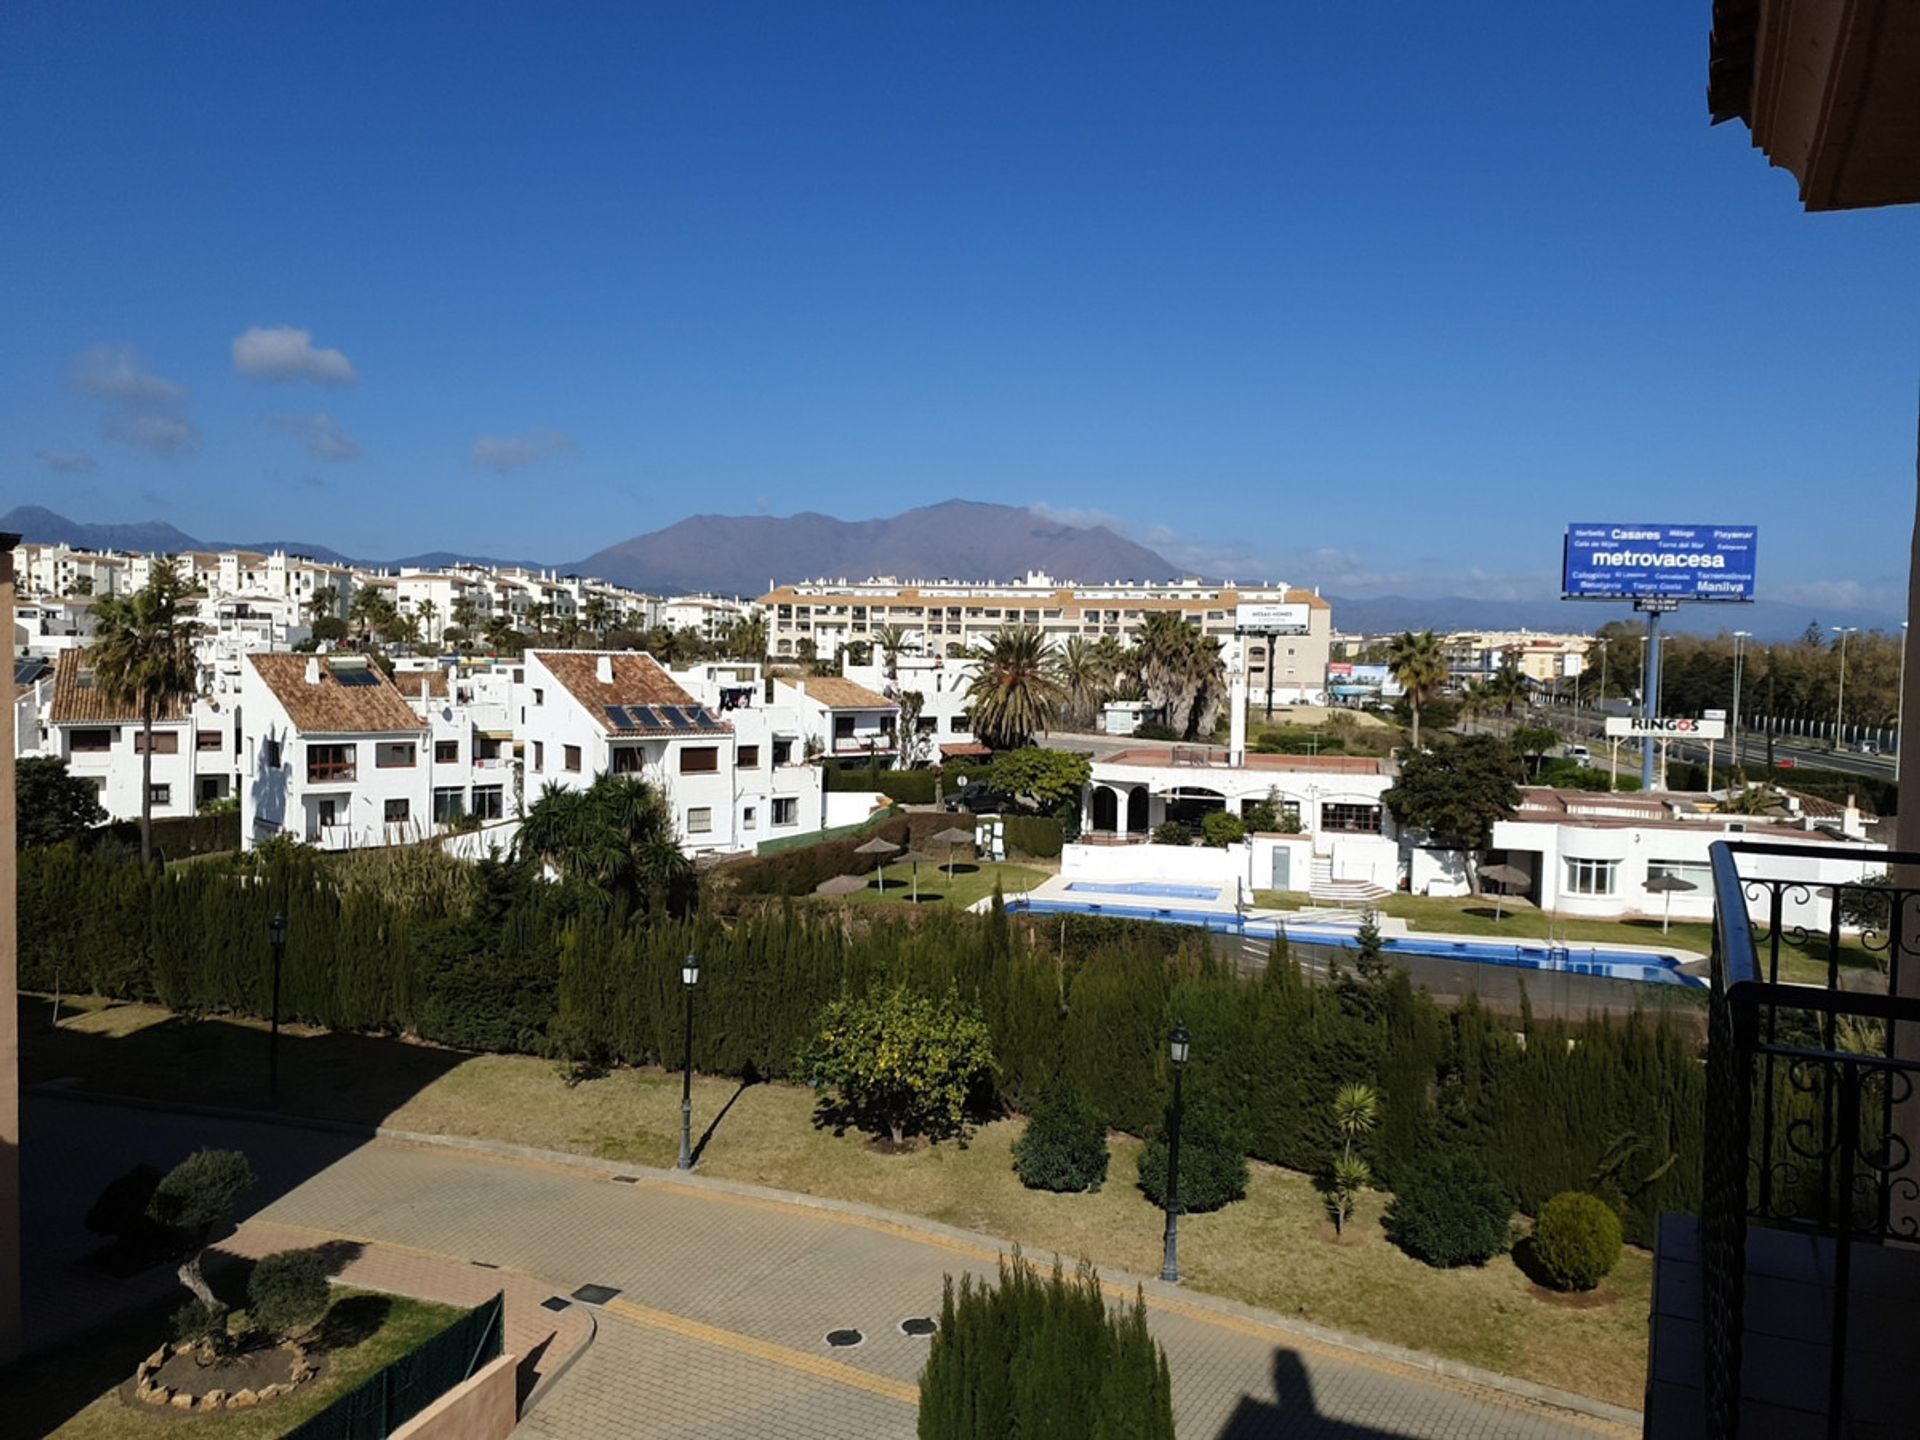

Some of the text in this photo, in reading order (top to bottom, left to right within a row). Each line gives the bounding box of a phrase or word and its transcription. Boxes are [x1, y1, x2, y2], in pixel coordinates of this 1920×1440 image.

[1611, 528, 1660, 540] Casares
[1592, 550, 1725, 568] metrovacesa
[1697, 571, 1752, 580] Torremolinos
[1697, 581, 1745, 592] Manilva
[1631, 718, 1700, 732] RINGOS
